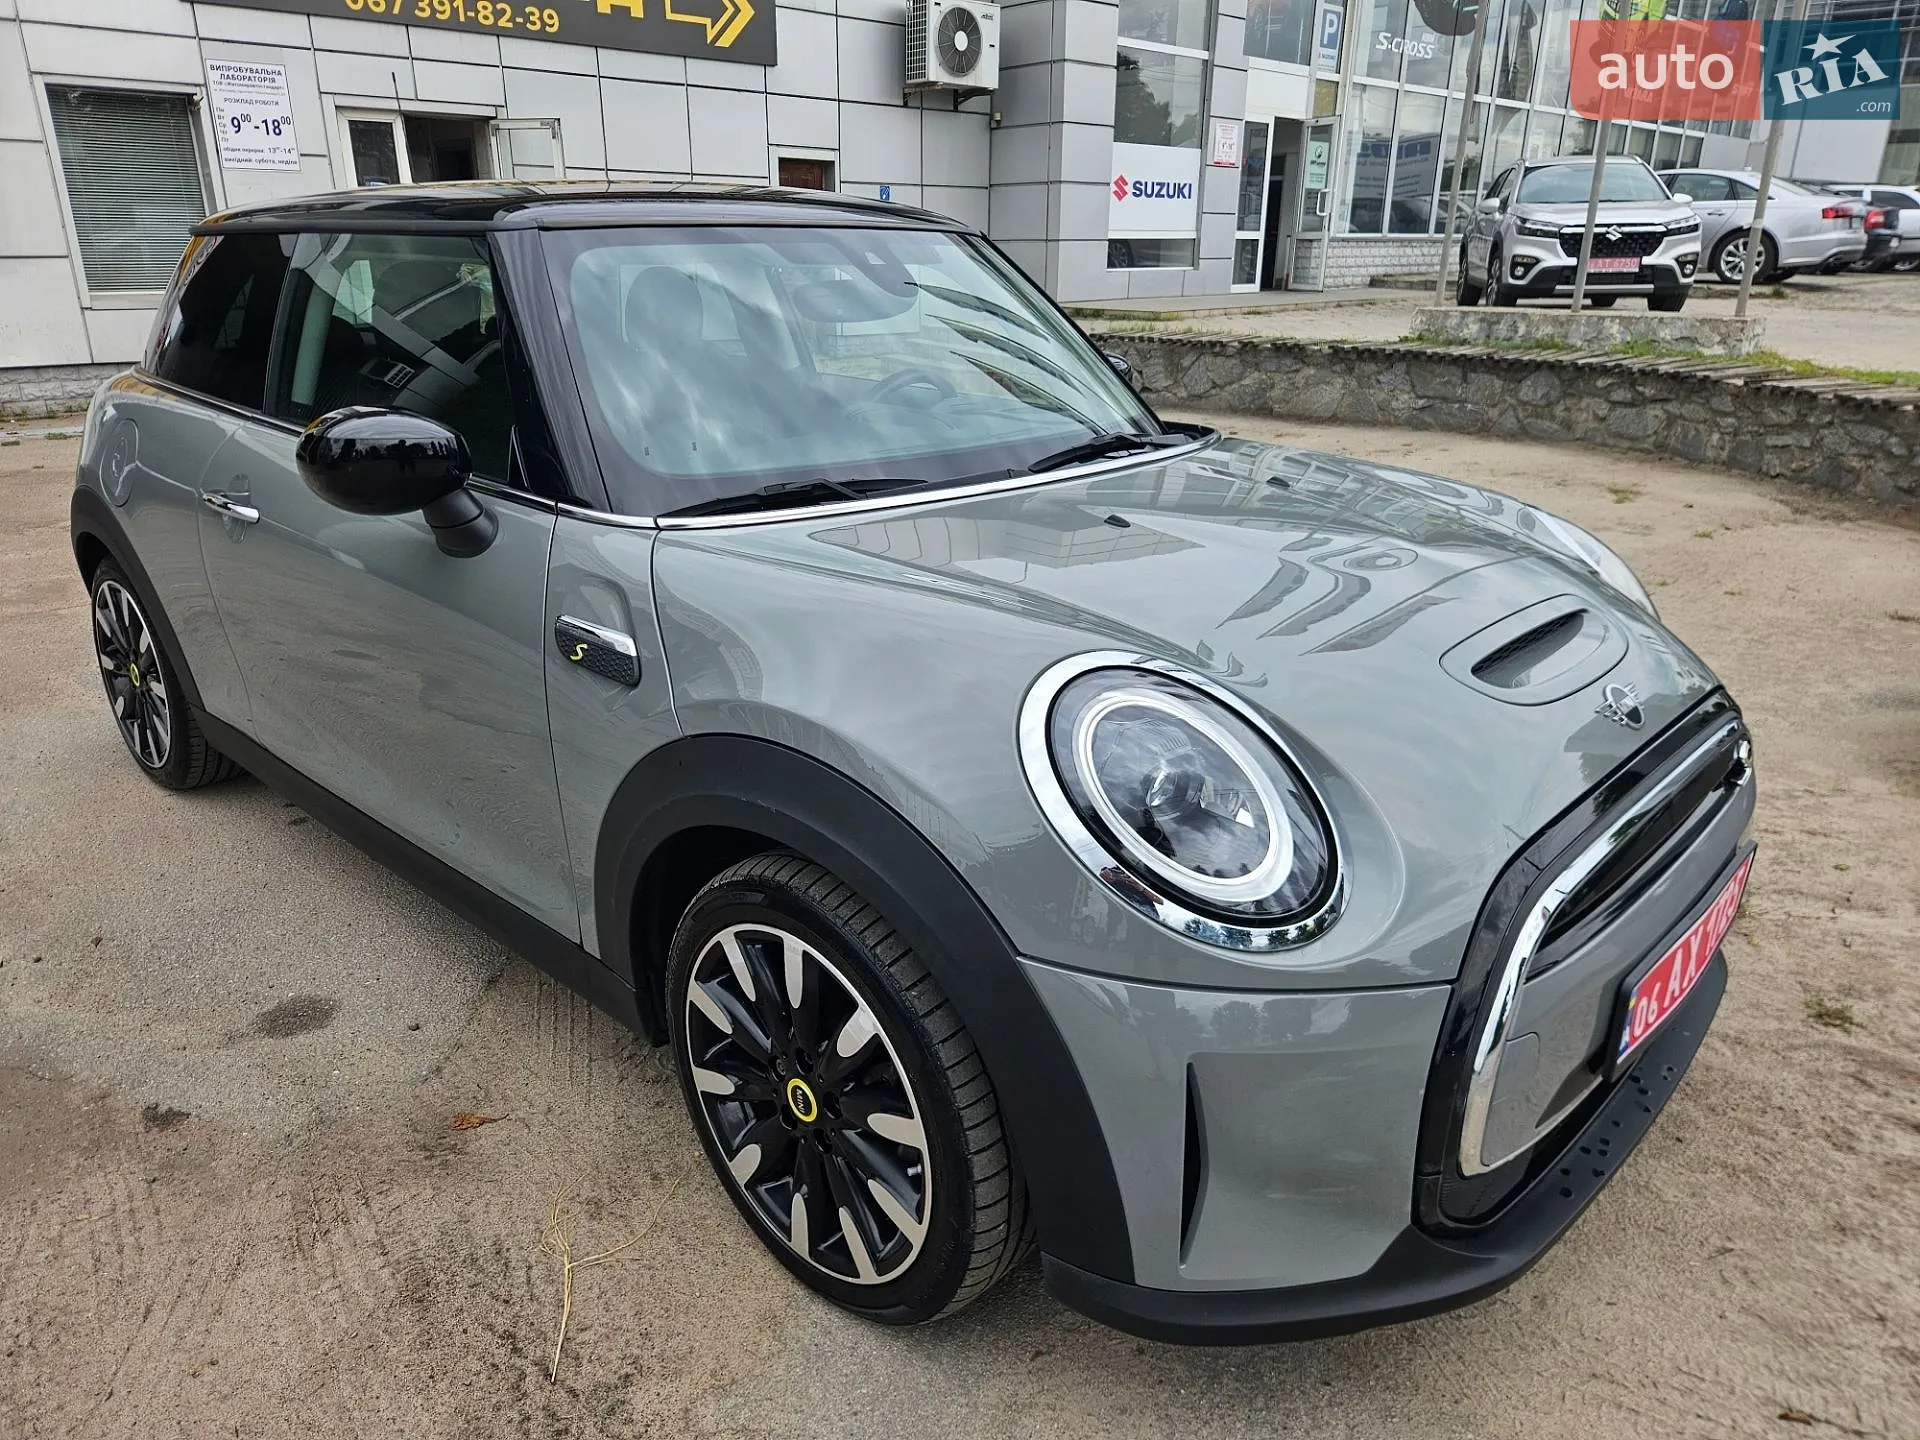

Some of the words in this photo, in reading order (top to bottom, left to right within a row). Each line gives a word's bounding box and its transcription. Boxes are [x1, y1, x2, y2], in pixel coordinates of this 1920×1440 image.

[414, 0, 560, 33] 391-82-39
[210, 64, 282, 77] ВИПРОБУВАЛЬНА
[220, 73, 276, 84] ЛАБОРАТОРІЯ
[1132, 180, 1192, 199] SUZUKI
[569, 643, 588, 661] S
[1633, 982, 1661, 1038] 06
[1663, 925, 1704, 1009] AX
